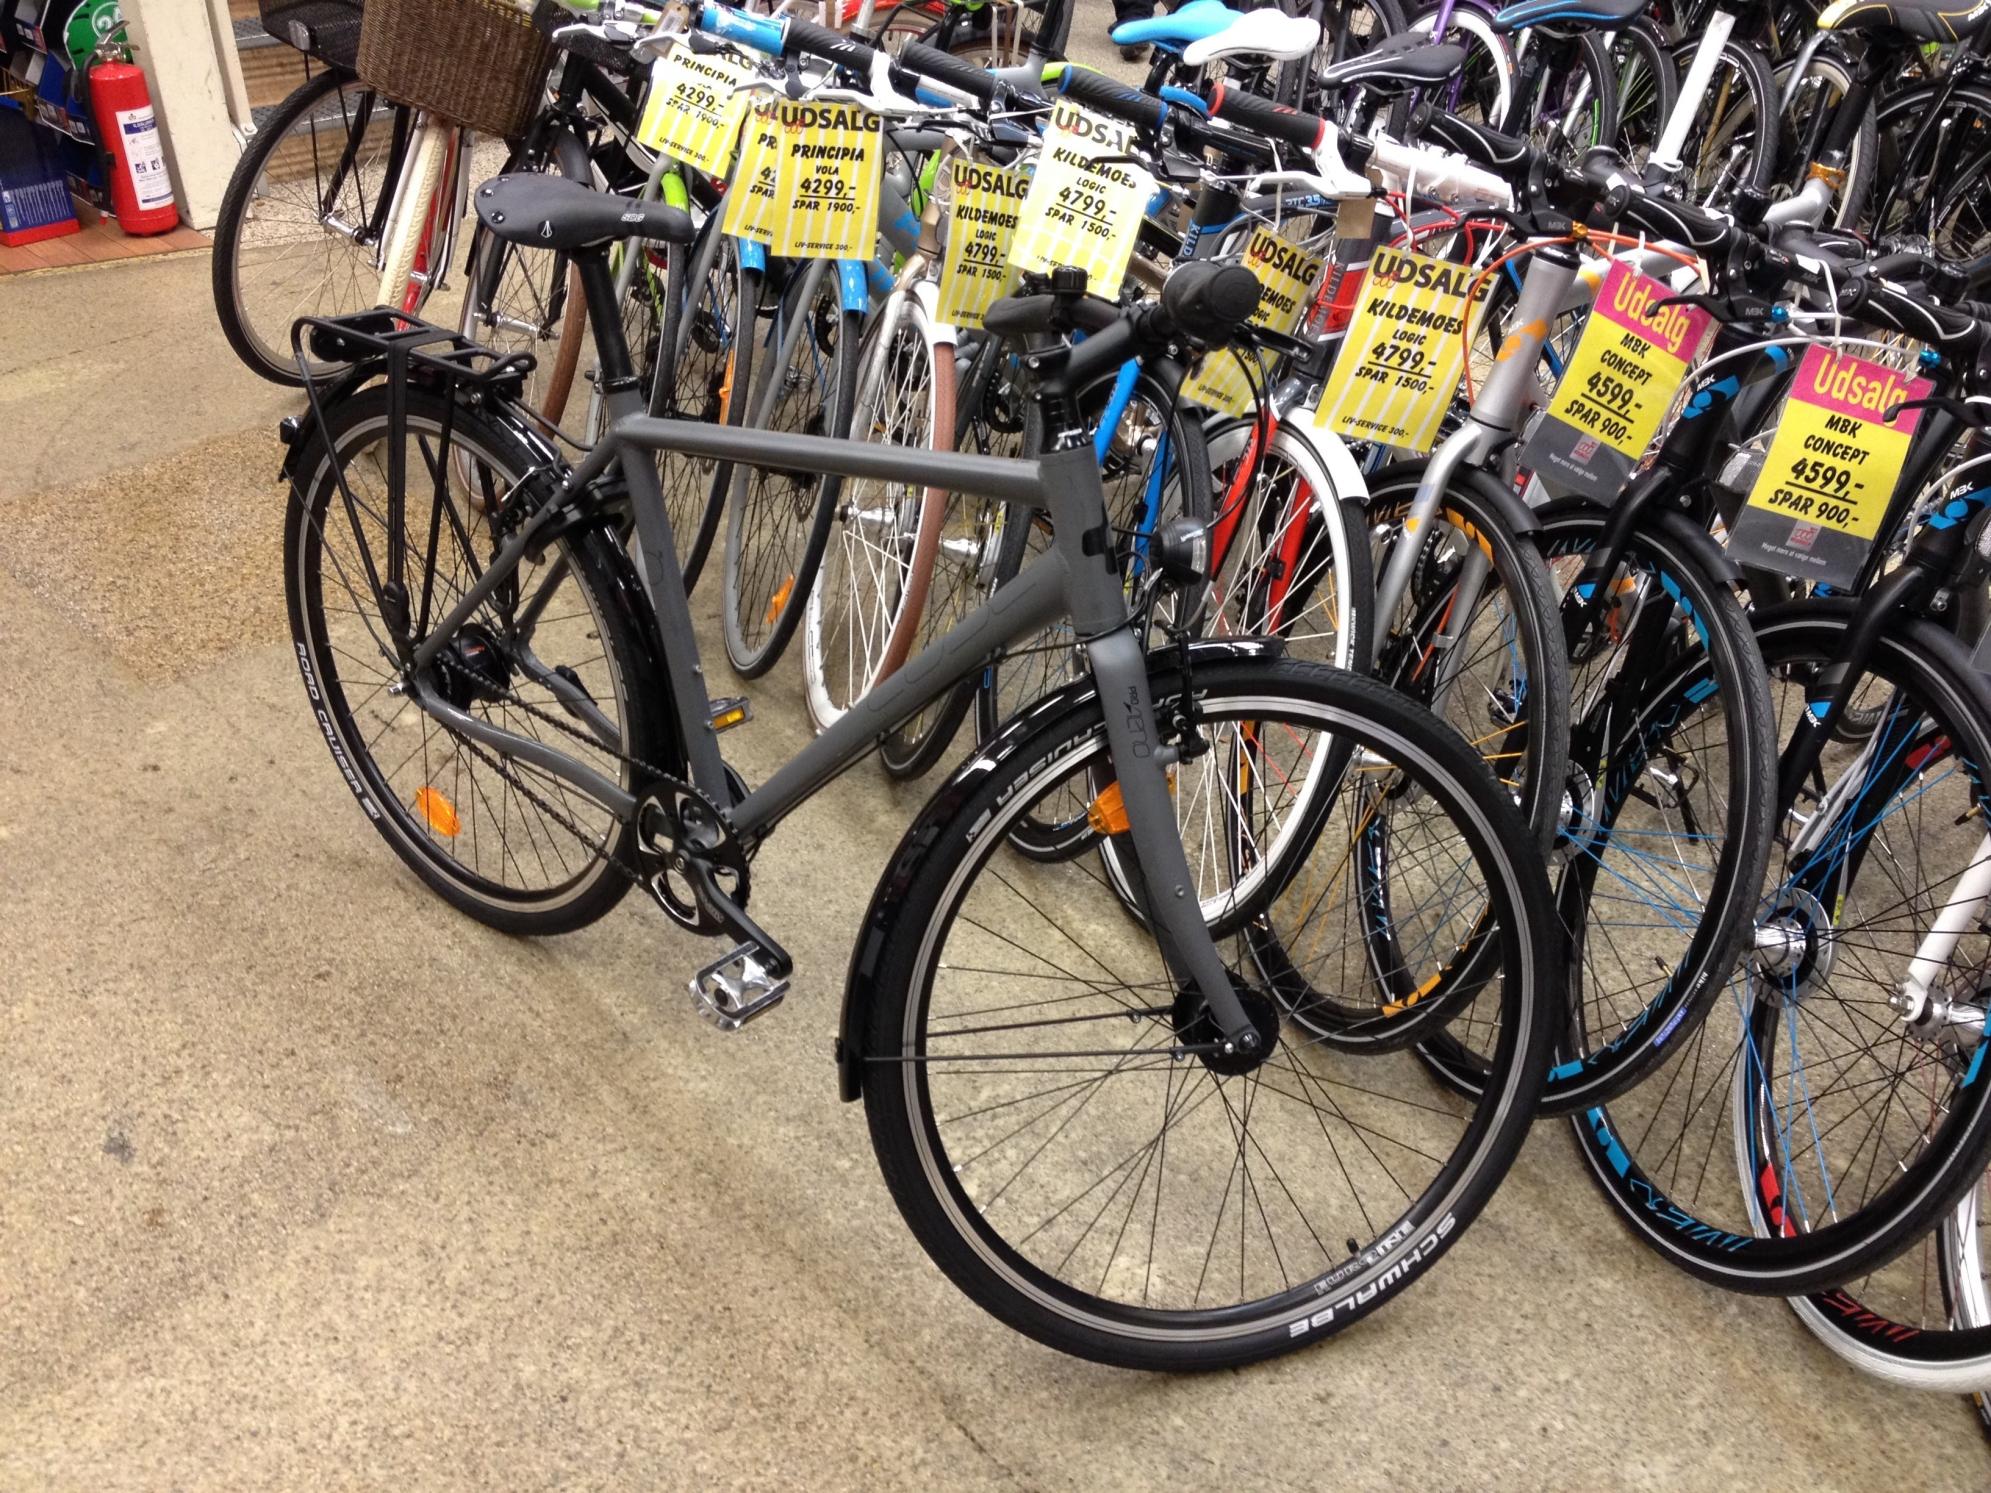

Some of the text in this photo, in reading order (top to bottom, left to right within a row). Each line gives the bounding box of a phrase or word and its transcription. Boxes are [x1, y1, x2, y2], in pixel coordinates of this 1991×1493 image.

[673, 54, 737, 87] PRINCIPIA
[666, 97, 691, 115] SPAR
[676, 82, 725, 112] 4299,-
[781, 106, 880, 132] UDSALG
[791, 143, 864, 162] PRINCIPIA
[815, 165, 839, 176] VOLA
[954, 164, 1029, 200] UDSALG
[749, 184, 775, 200] SPAR
[800, 177, 856, 200] 4299,-
[1076, 177, 1107, 194] LOGIC
[792, 199, 860, 215] SPAR 1900,-
[956, 204, 1018, 229] KILDEMOES
[1058, 186, 1117, 221] 4799,-
[743, 224, 773, 237] LIV-SERV
[975, 229, 997, 241] LOGIC
[1045, 206, 1117, 241] SPAR 1500,-
[794, 241, 833, 250] LIV-SERVICE
[964, 241, 1006, 265] 4799,-
[1249, 232, 1319, 286] UDSALG
[956, 263, 1007, 282] SPAR 1500,-
[1372, 252, 1492, 303] UDSALG
[1258, 281, 1297, 315] DEMOES
[1252, 309, 1271, 322] OGIC
[1366, 297, 1464, 335] KILDEMOES
[1392, 329, 1427, 346] LOGIC
[1620, 332, 1652, 359] MBK
[1371, 341, 1437, 374] 4799,-
[1600, 349, 1653, 386] CONCEPT
[1355, 366, 1434, 395] SPAR 1500,-
[1586, 370, 1642, 416] 4599,-
[1341, 415, 1389, 433] LIV-SERVICE
[1564, 399, 1633, 446] SPAR 900,-
[1824, 414, 1863, 438] MBK
[1803, 434, 1870, 465] CONCEPT
[1790, 457, 1864, 499] 4599,-
[1768, 488, 1859, 529] SPAR 900,-
[296, 641, 363, 794] ROAD CRUISER
[1289, 1212, 1456, 1338] SCHWALBE
